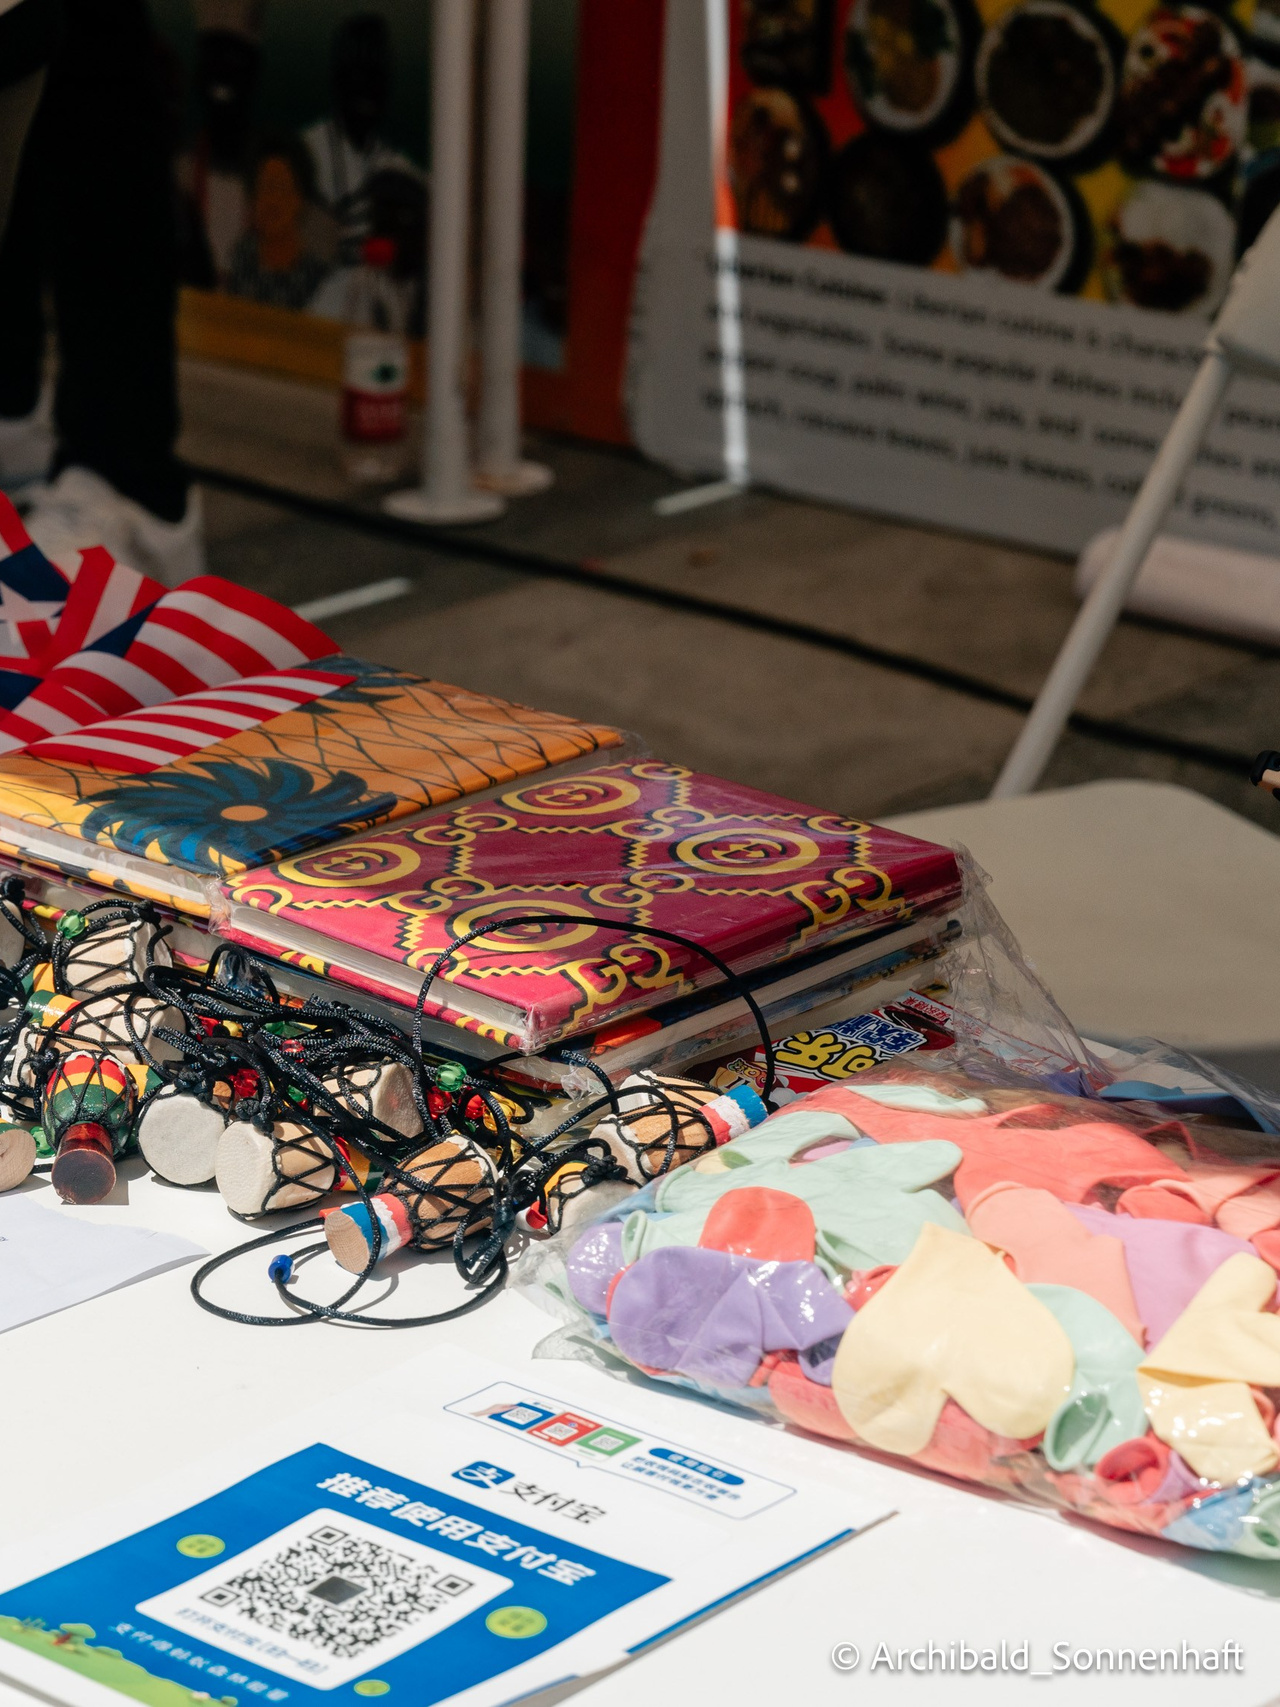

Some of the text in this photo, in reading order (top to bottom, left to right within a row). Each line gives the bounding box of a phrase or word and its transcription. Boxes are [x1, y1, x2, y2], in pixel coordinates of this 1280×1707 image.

[316, 1472, 597, 1587] 推荐使用支付宝
[499, 1480, 609, 1525] 支付宝
